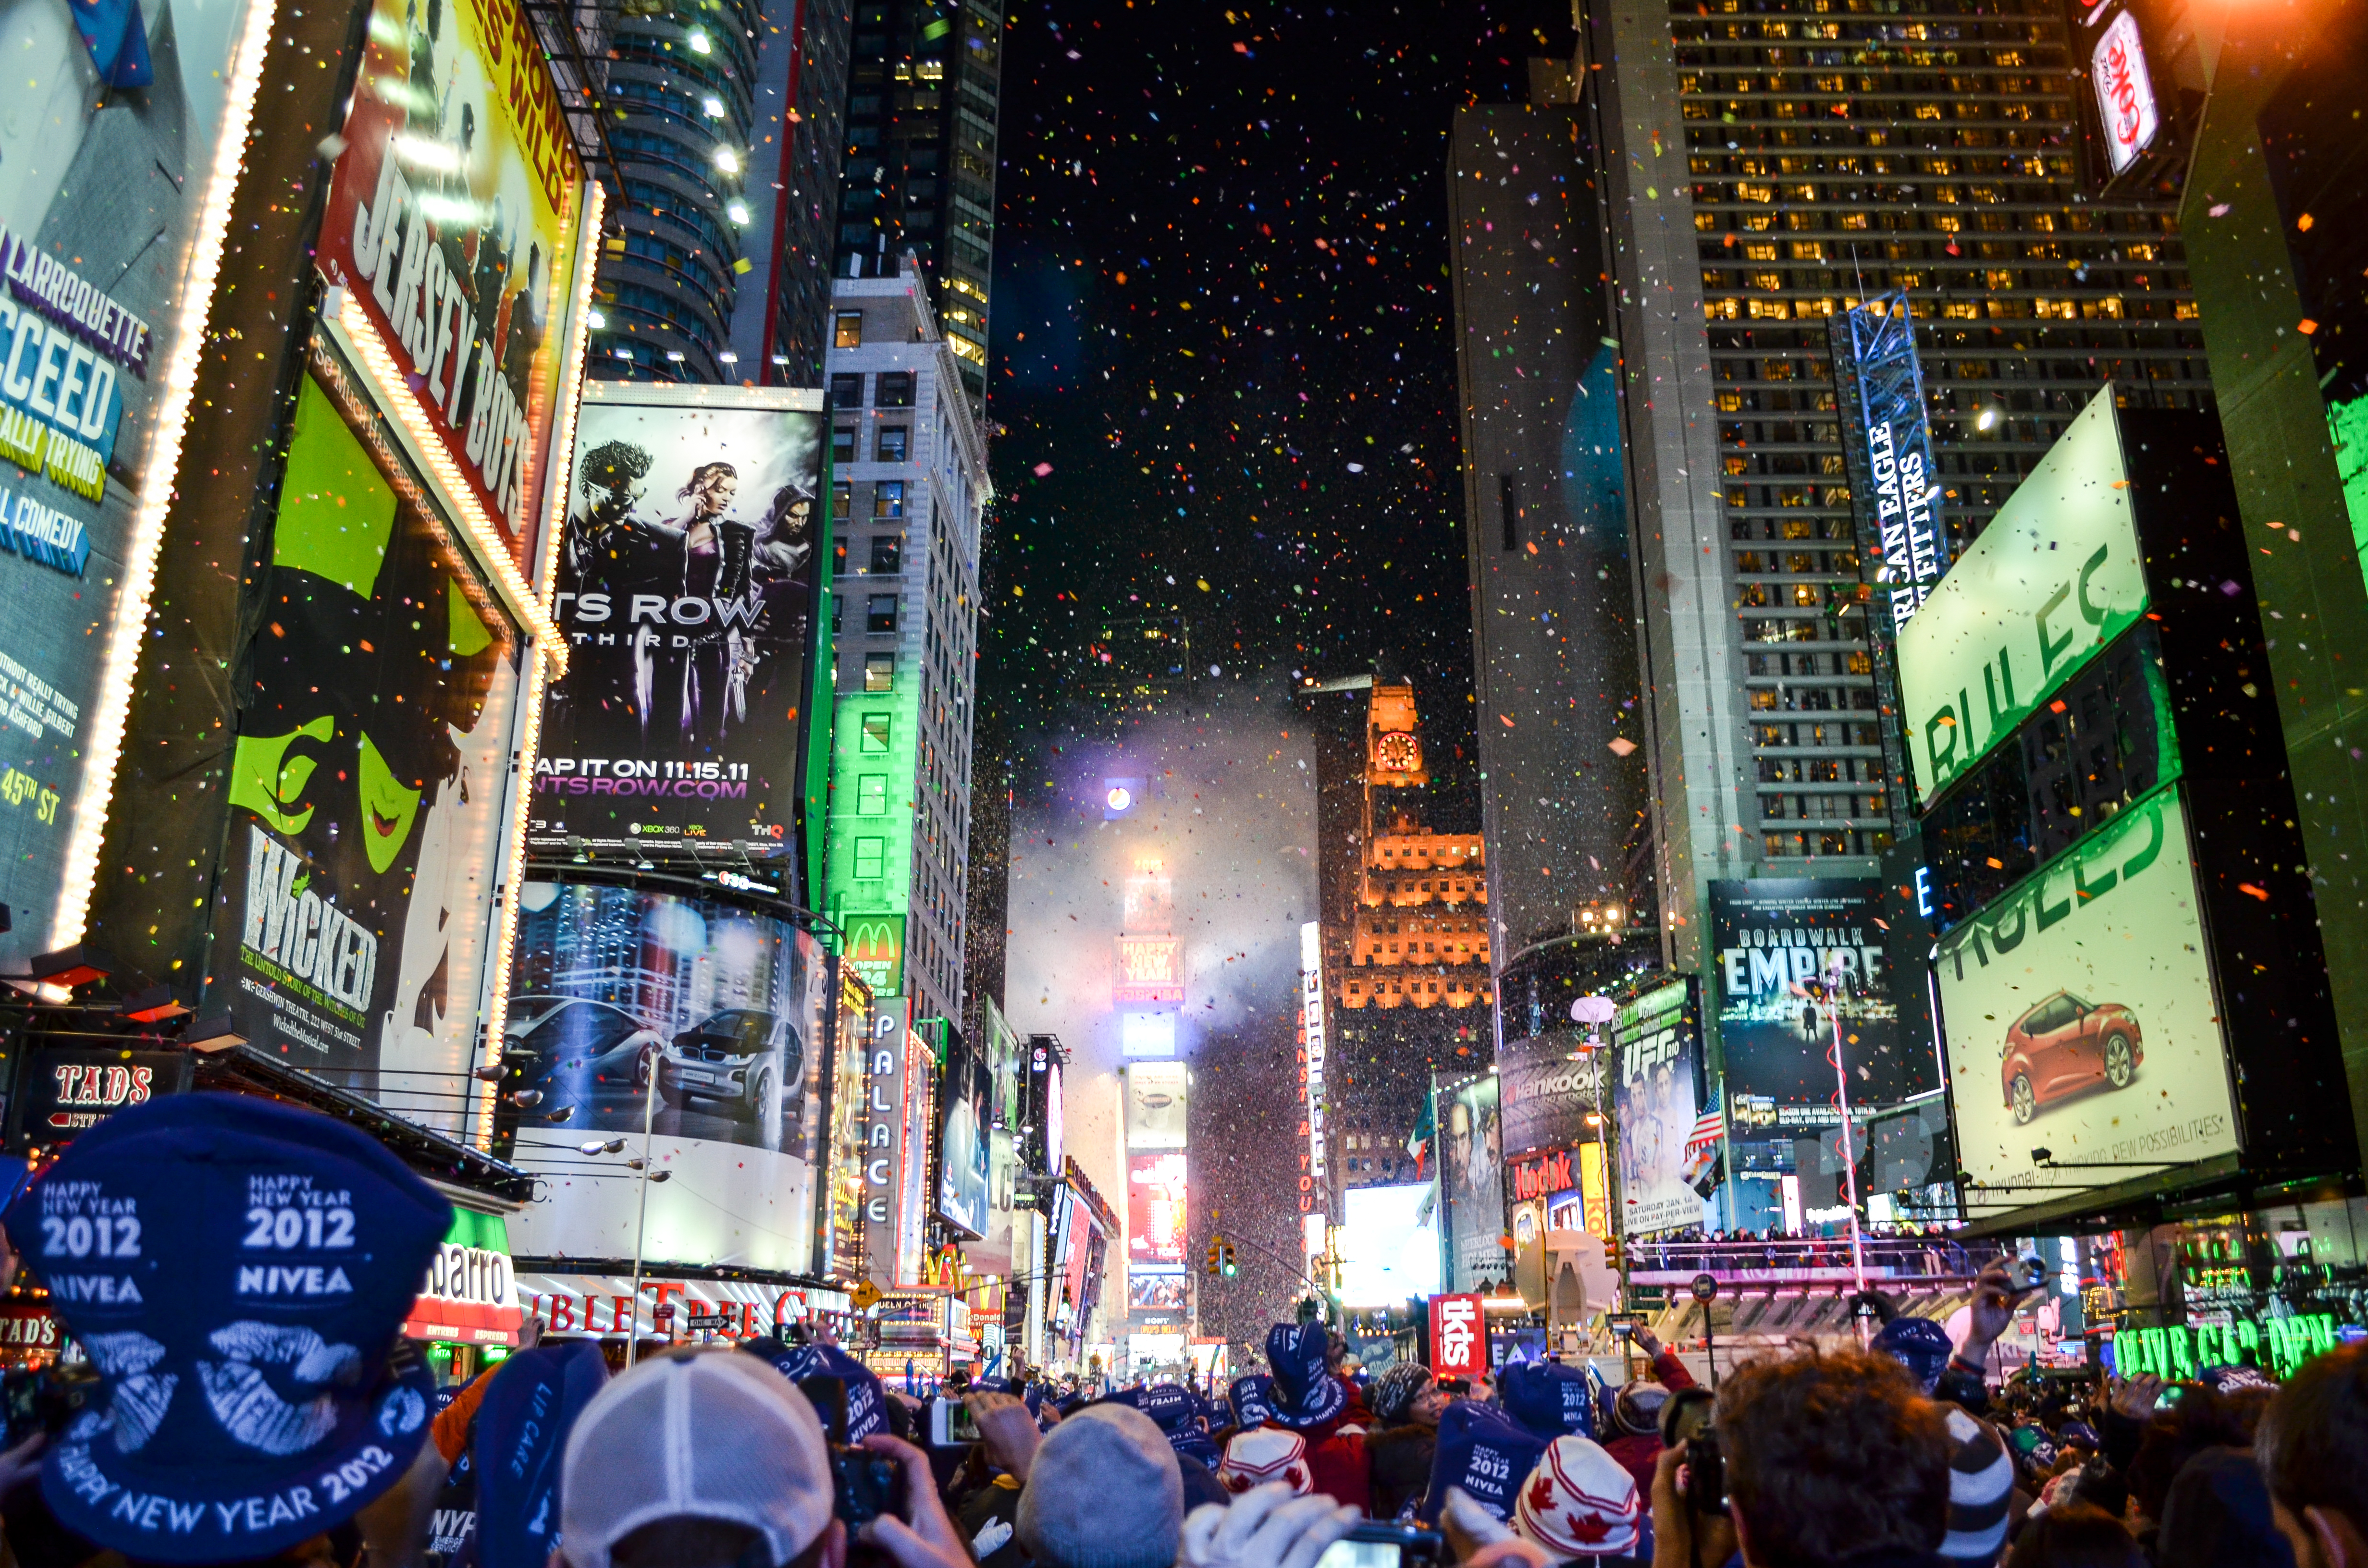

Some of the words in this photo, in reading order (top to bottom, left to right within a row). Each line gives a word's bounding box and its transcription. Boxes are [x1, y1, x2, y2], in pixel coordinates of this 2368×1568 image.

[6, 234, 149, 361] LARROQUETTE
[352, 144, 478, 429] JERSEY
[466, 337, 532, 537] BOYS
[315, 334, 333, 377] SO
[46, 427, 102, 485] TRYING
[1869, 421, 1901, 519] EAGLE
[14, 497, 84, 552] COMEDY
[630, 594, 766, 628] ROW
[572, 632, 690, 648] THIRD
[26, 673, 54, 701] REALLY
[53, 690, 78, 720] TRYING
[8, 706, 43, 738] ASHFORD
[19, 689, 45, 718] WILLIE
[45, 708, 75, 738] GILBERT
[582, 759, 609, 776] IT
[613, 760, 657, 778] ON
[666, 761, 749, 781] 11.15.11
[38, 788, 60, 825] ST
[642, 824, 664, 833] XBOX
[665, 825, 680, 834] 360
[752, 824, 784, 840] THQ
[1122, 942, 1177, 955] HAPPY
[1739, 928, 1864, 947] BOARDWALK
[241, 945, 254, 966] THE
[255, 954, 282, 981] UNTOLD
[303, 985, 312, 998] OF
[311, 994, 323, 1006] THE
[853, 960, 892, 970] OPEN
[1125, 966, 1172, 981] YEAR!
[1131, 954, 1168, 968] NEW
[860, 970, 887, 986] 24
[1114, 988, 1184, 1002] TOSHIBA
[255, 983, 285, 1009] GERSHWIN
[343, 1031, 361, 1048] STREET
[1297, 1010, 1308, 1102] ERNST
[1623, 1028, 1675, 1089] UFC
[1666, 1041, 1679, 1058] RIO
[867, 1014, 896, 1224] PALACE
[1298, 1121, 1310, 1136] &
[2112, 1139, 2137, 1161] NEW
[44, 1181, 102, 1198] HAPPY
[248, 1175, 314, 1191] HAPPY
[43, 1198, 81, 1215] NEW
[88, 1198, 136, 1214] YEAR
[248, 1190, 295, 1207] NEW
[299, 1190, 352, 1206] YEAR
[1629, 1201, 1664, 1216] SATURDAY
[1666, 1197, 1683, 1208] JAN.
[1684, 1195, 1693, 1204] 14
[243, 1208, 357, 1248] 2012
[1624, 1217, 1638, 1226] LIVE
[1640, 1215, 1650, 1224] ON
[1651, 1204, 1700, 1222] PAY-PER-VIEW
[40, 1215, 142, 1257] 2012
[49, 1274, 143, 1303] NIVEA
[238, 1265, 354, 1295] NIVEA
[420, 1243, 505, 1306] barro
[0, 1315, 56, 1345] TAD'S
[427, 1324, 459, 1338] ENTREES
[475, 1329, 508, 1342] ESPRESSO
[1442, 1298, 1476, 1367] tkts
[1563, 1393, 1586, 1407] 2012
[851, 1412, 880, 1444] NIVEA
[1469, 1456, 1510, 1480] 2012
[111, 1490, 206, 1533] NEW
[215, 1486, 320, 1534] YEAR
[321, 1445, 394, 1505] 2012
[1465, 1474, 1504, 1496] NIVEA
